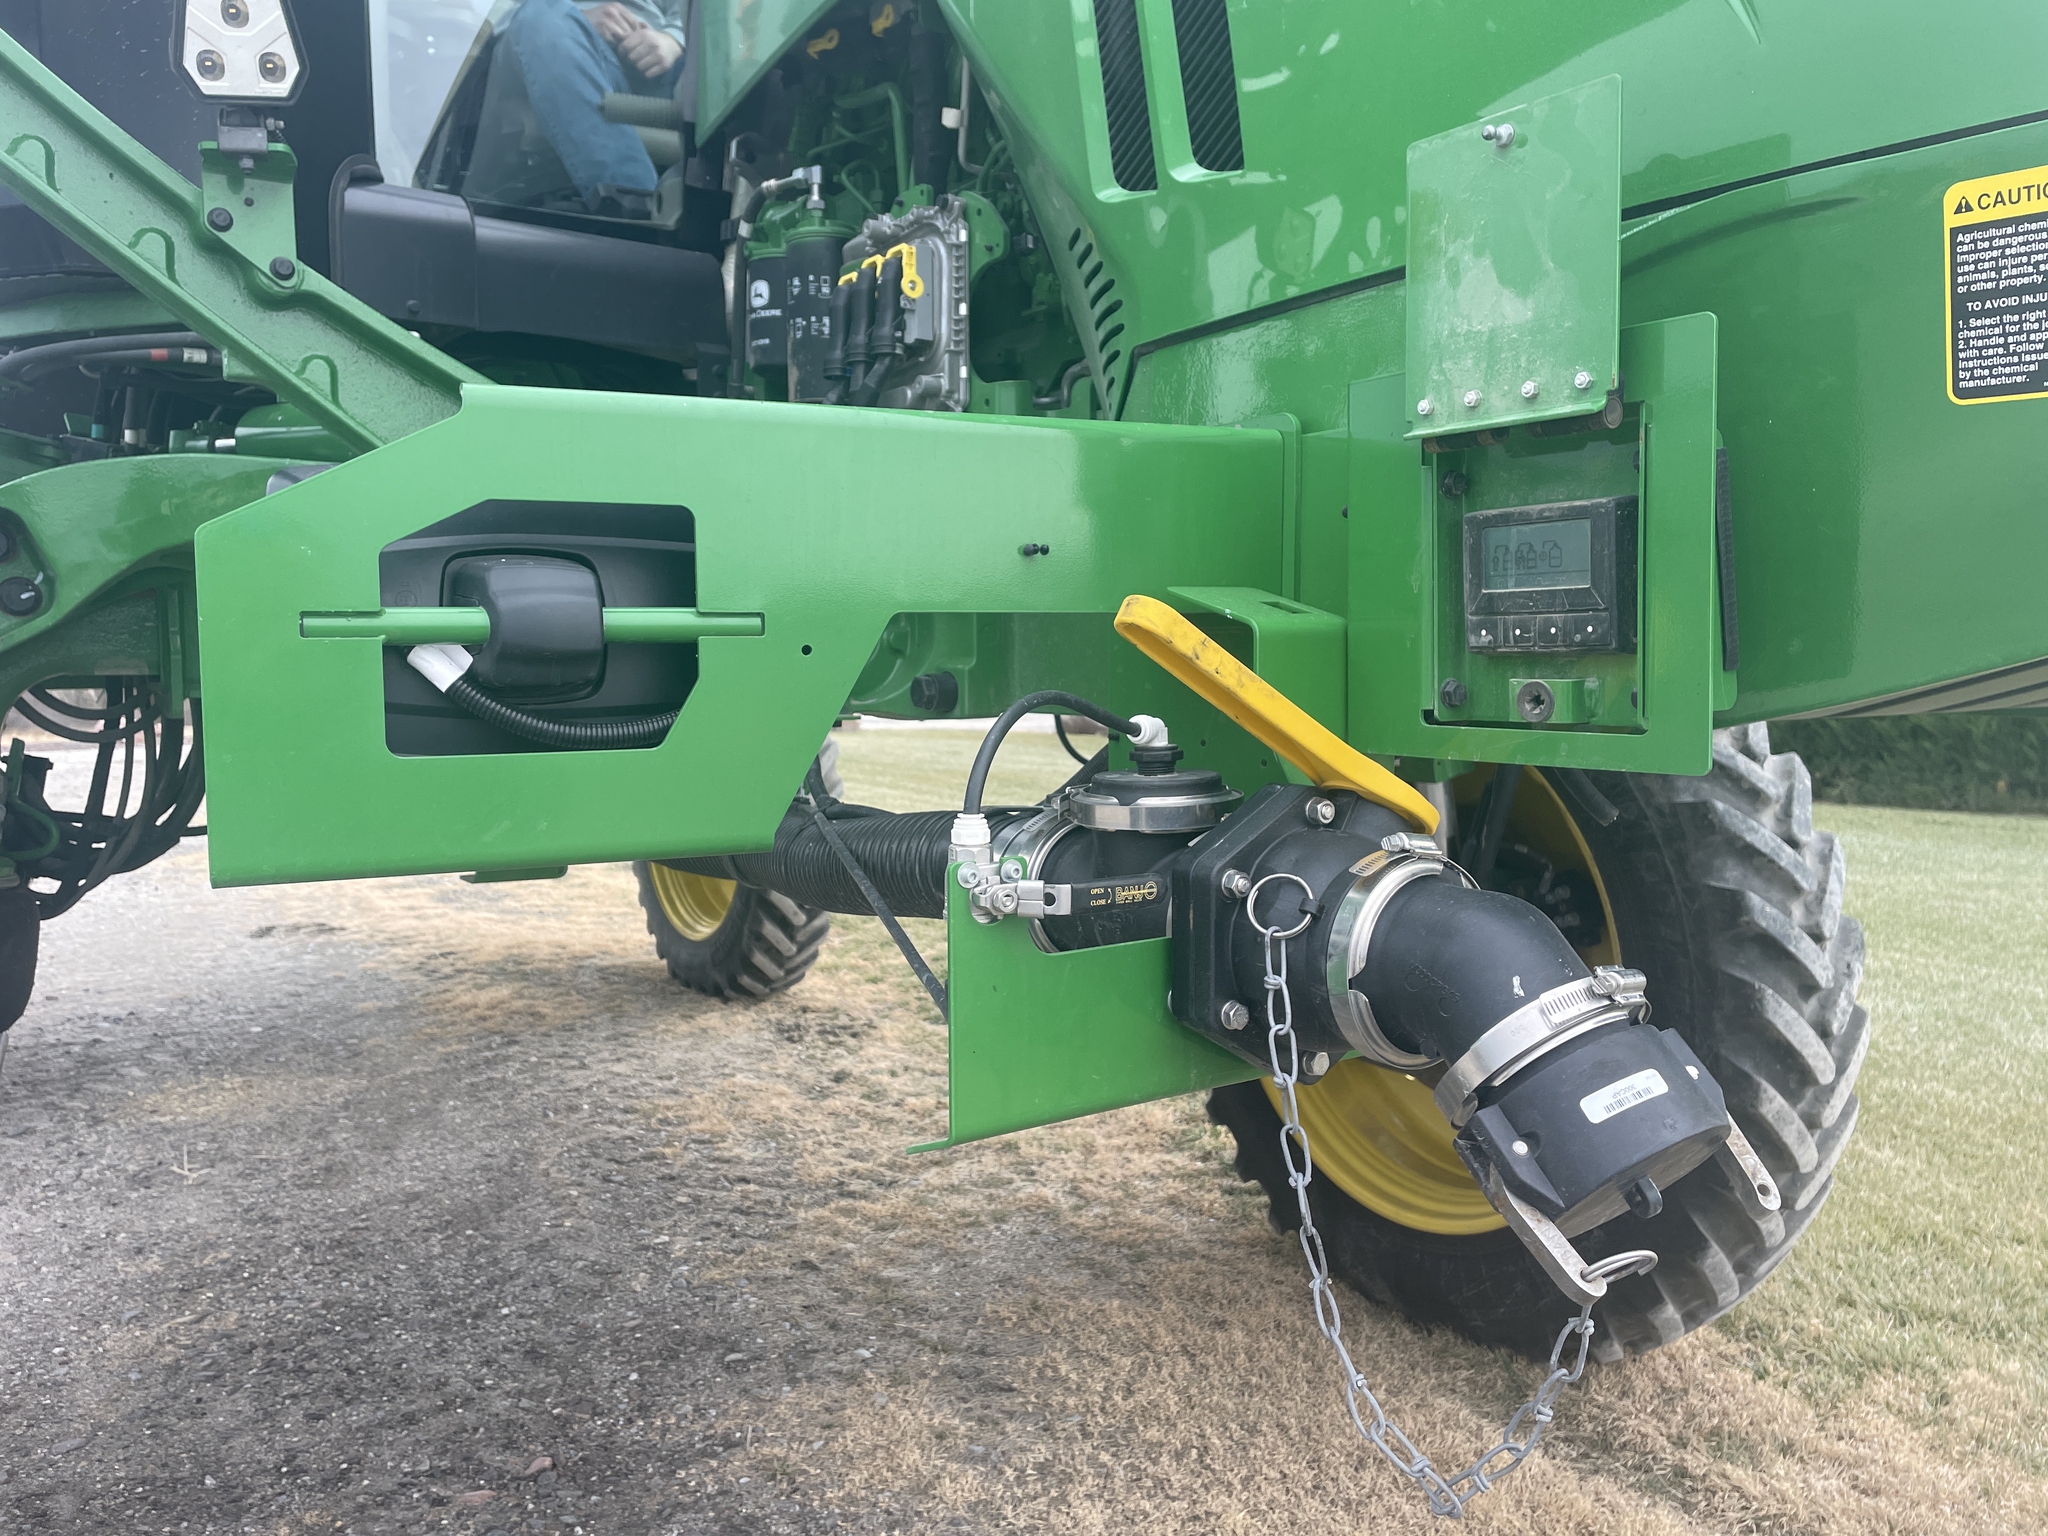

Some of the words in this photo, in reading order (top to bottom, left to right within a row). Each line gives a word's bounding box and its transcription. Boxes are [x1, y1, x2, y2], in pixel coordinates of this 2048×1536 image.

[1956, 224, 2016, 243] Agricultural
[1956, 243, 1974, 252] can
[1977, 240, 1990, 250] be
[1992, 232, 2048, 246] dangerous
[1957, 249, 2002, 263] Improper
[1957, 264, 1975, 273] use
[1978, 260, 1996, 270] can
[1998, 256, 2028, 268] injure
[1957, 270, 1998, 284] animals,
[2002, 264, 2036, 278] plants,
[1957, 285, 1968, 294] or
[1970, 280, 1997, 292] other
[1999, 274, 2046, 290] property.
[1966, 302, 1982, 312] TO
[1984, 296, 2020, 310] AVOID
[2022, 292, 2048, 304] INJU
[1958, 320, 1966, 328] 1.
[1968, 316, 2000, 328] Select
[2002, 314, 2020, 322] the
[2022, 309, 2046, 322] right
[1958, 325, 2002, 338] chemical
[2005, 324, 2020, 333] for
[2022, 322, 2039, 330] the
[1958, 340, 1967, 349] 2.
[1969, 336, 2004, 348] Handle
[2007, 332, 2026, 344] and
[1958, 349, 1979, 358] with
[1982, 347, 2006, 356] care.
[2010, 342, 2044, 353] Follow
[1958, 354, 2019, 368] instructions
[1958, 370, 1971, 380] by
[1974, 368, 1990, 378] the
[1992, 362, 2038, 375] chemical
[1959, 374, 2030, 388] manufacturer.
[1090, 887, 1104, 895] OPEN
[1612, 1084, 1638, 1100] 300CAP
